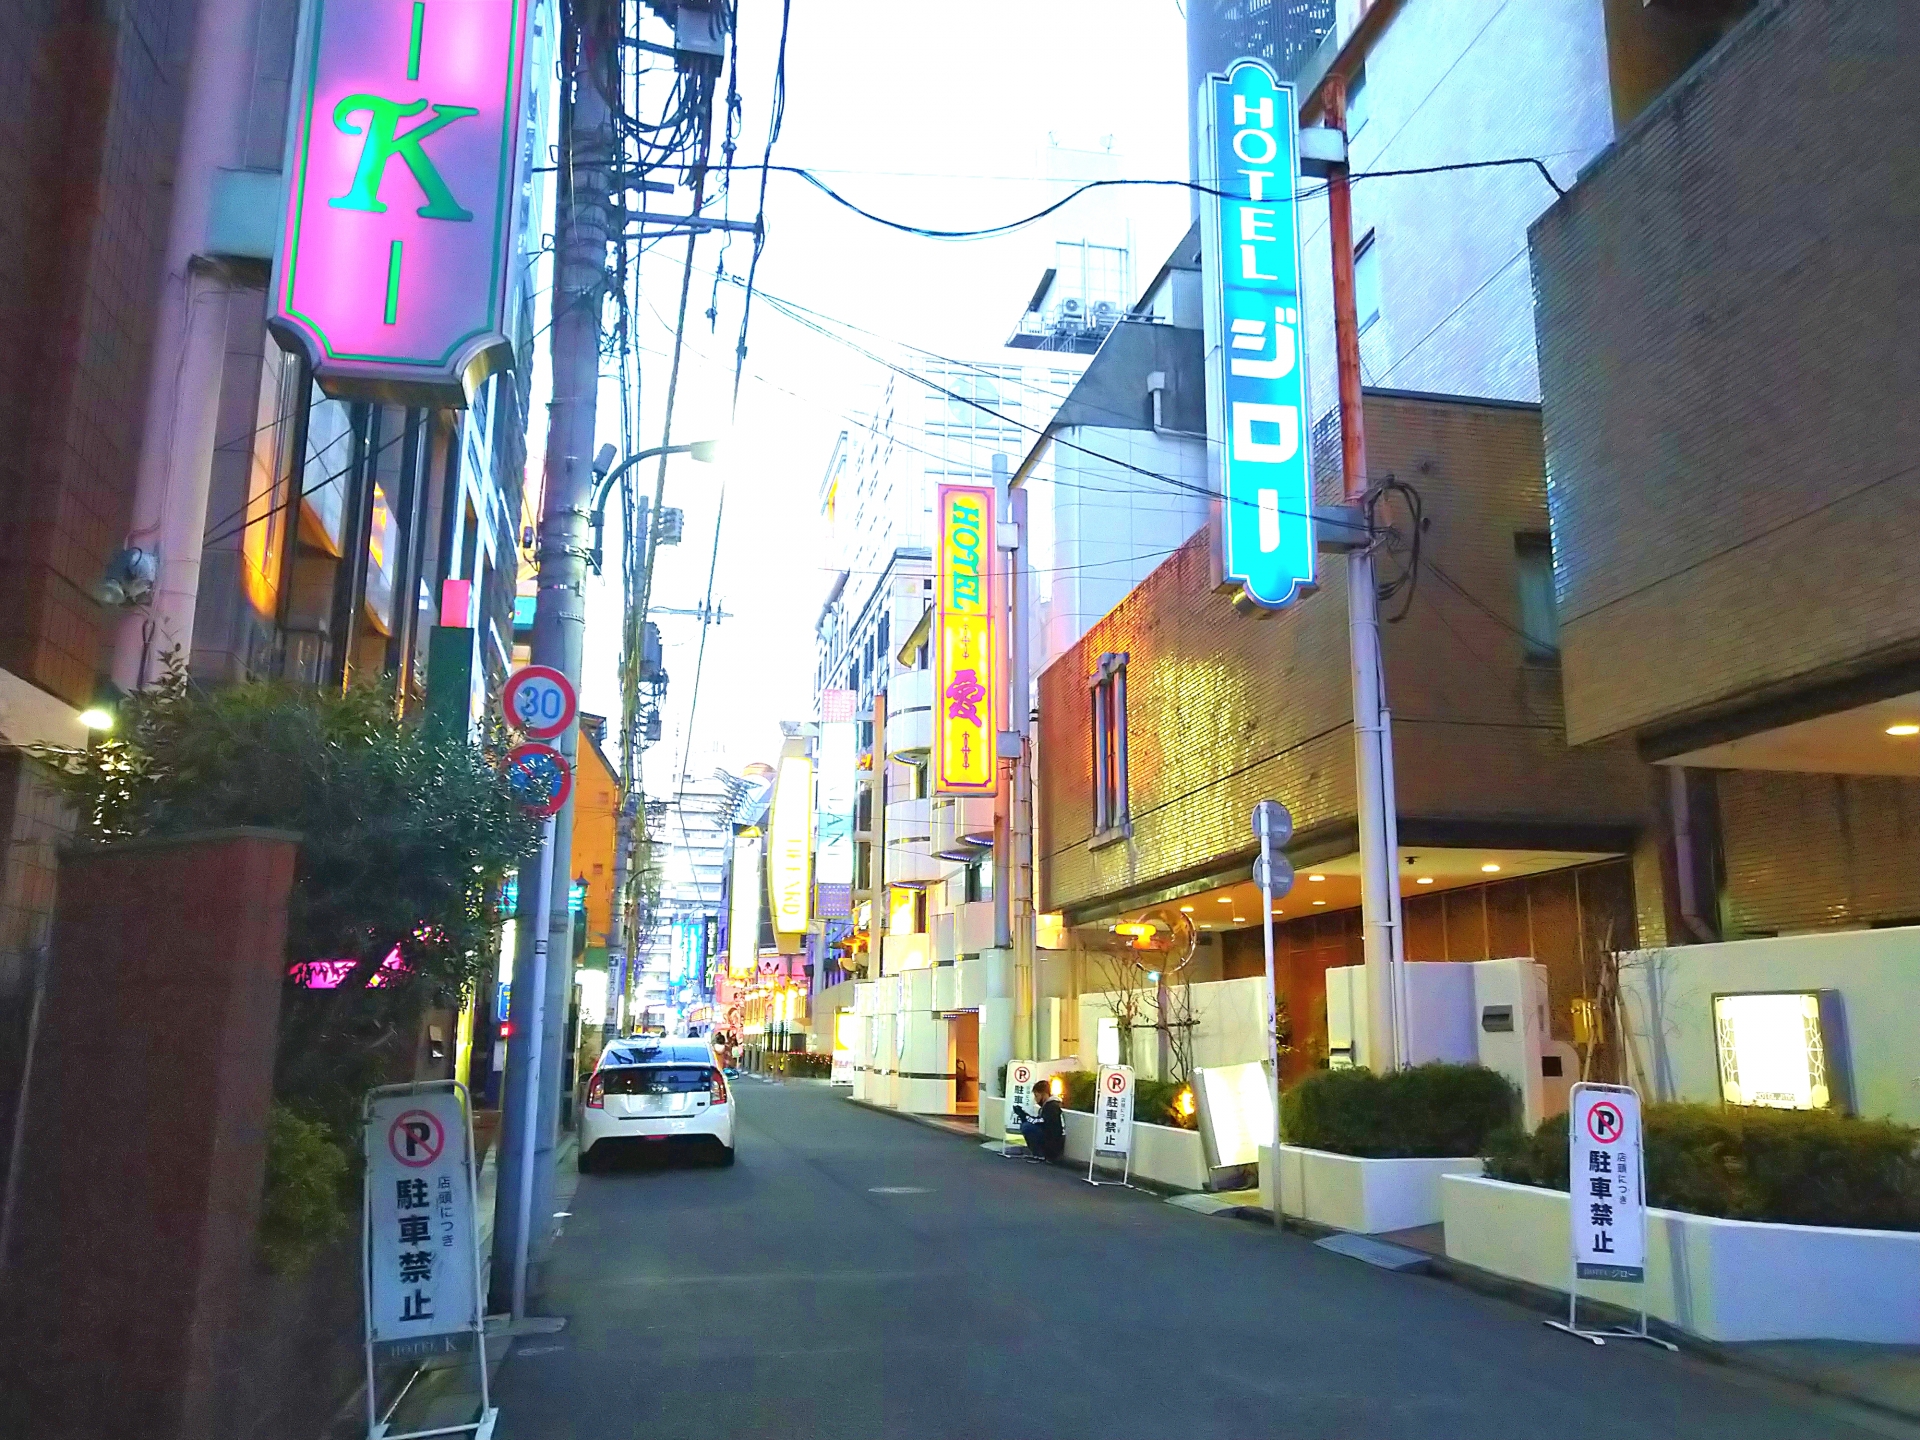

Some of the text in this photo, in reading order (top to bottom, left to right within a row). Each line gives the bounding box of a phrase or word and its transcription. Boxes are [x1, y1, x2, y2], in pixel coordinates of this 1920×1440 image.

[328, 93, 480, 222] K
[1229, 93, 1300, 554] HOTEL ジロー
[946, 501, 986, 729] HOTEL 愛
[520, 685, 563, 721] 30
[1012, 1085, 1024, 1125] 駐車止
[1104, 1096, 1119, 1146] 駐車禁止
[437, 1175, 454, 1247] 店頭につき
[1588, 1150, 1615, 1254] 駐車禁止
[1617, 1152, 1628, 1205] 店頭につき
[396, 1178, 435, 1322] 駐車禁止
[1611, 1269, 1637, 1278] ジロー
